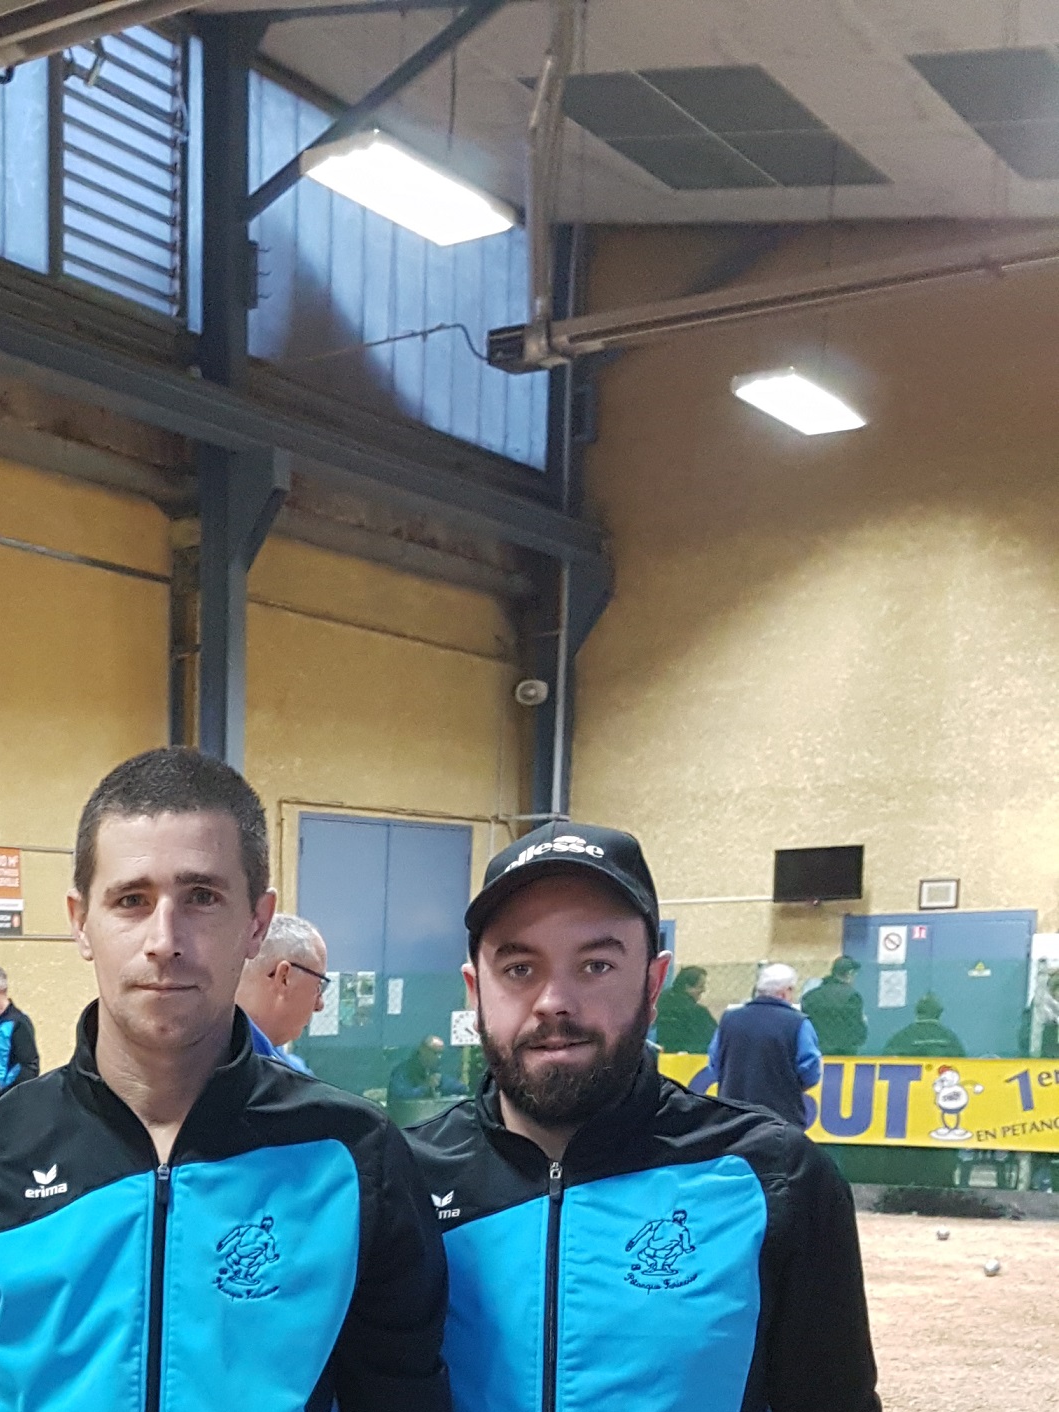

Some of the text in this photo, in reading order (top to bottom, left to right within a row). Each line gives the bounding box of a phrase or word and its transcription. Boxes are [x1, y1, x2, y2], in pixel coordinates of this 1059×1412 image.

[504, 842, 605, 873] ellesse
[976, 1129, 997, 1142] EN
[25, 1182, 68, 1198] erima
